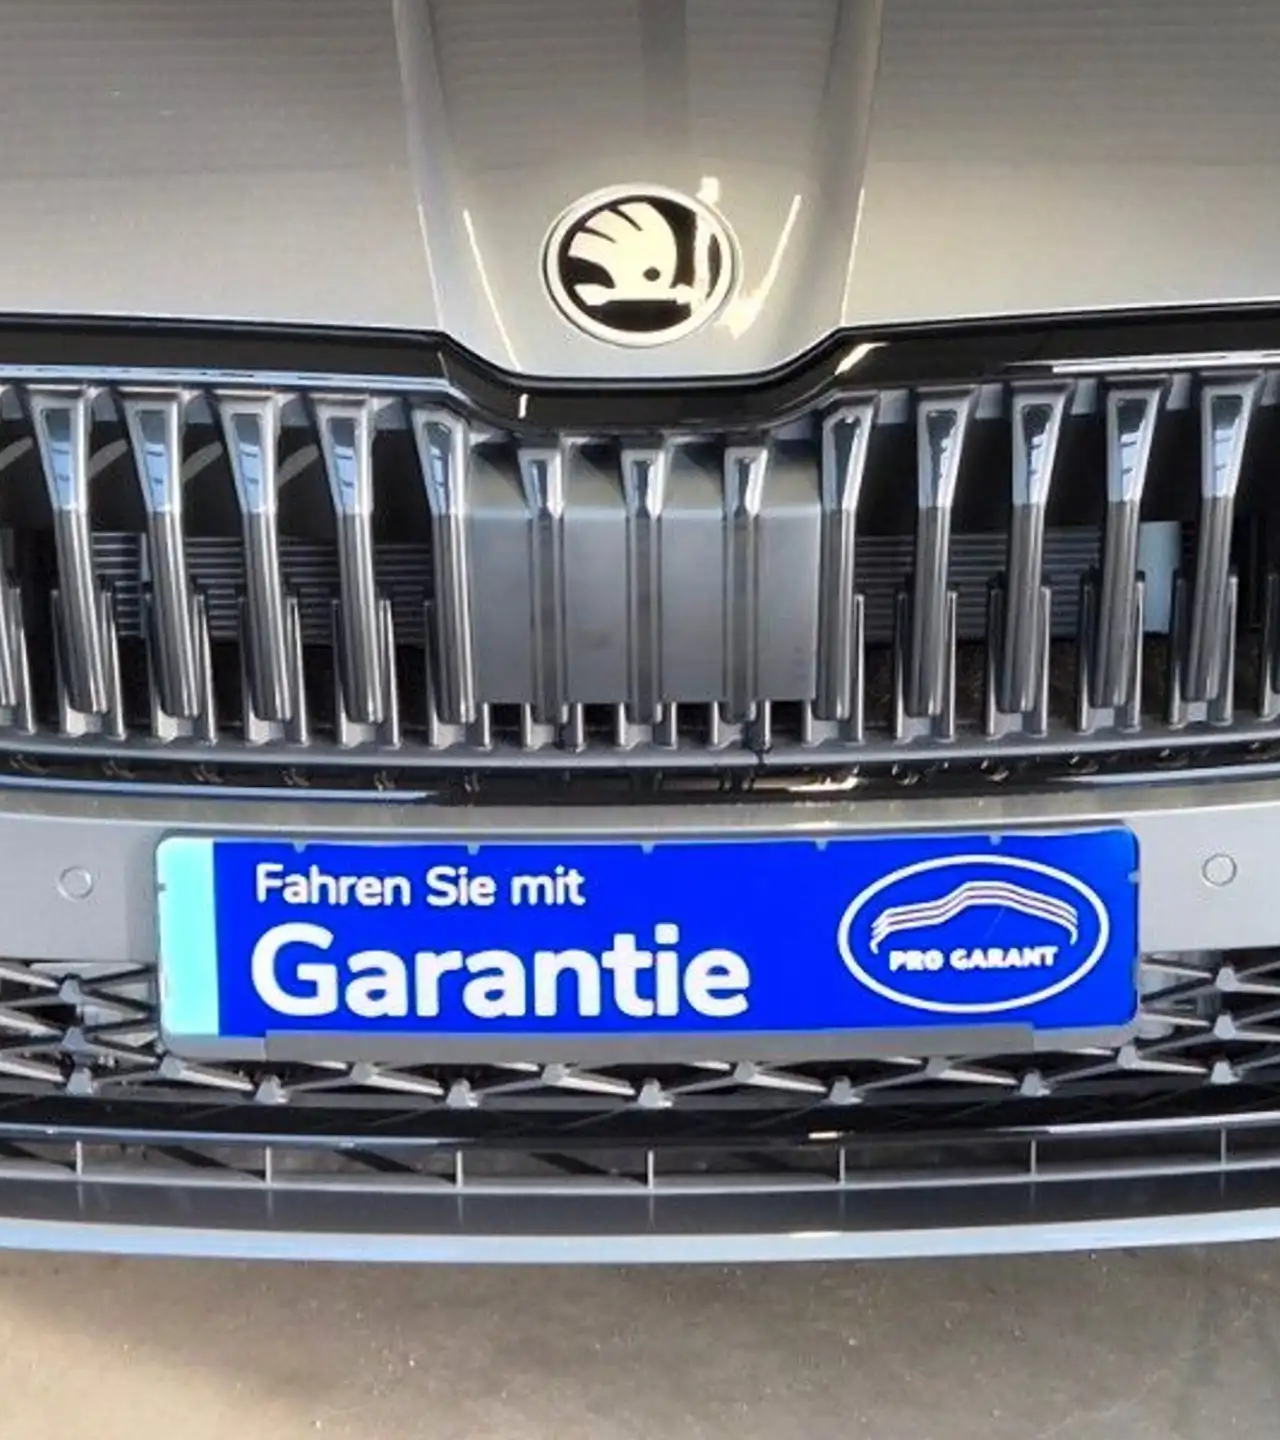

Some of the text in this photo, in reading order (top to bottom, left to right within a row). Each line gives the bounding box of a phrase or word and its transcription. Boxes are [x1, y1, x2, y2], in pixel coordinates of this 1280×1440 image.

[256, 862, 586, 906] Fahren Sie mit
[250, 921, 751, 1019] Garantie
[888, 945, 1059, 972] PRO GARANT
